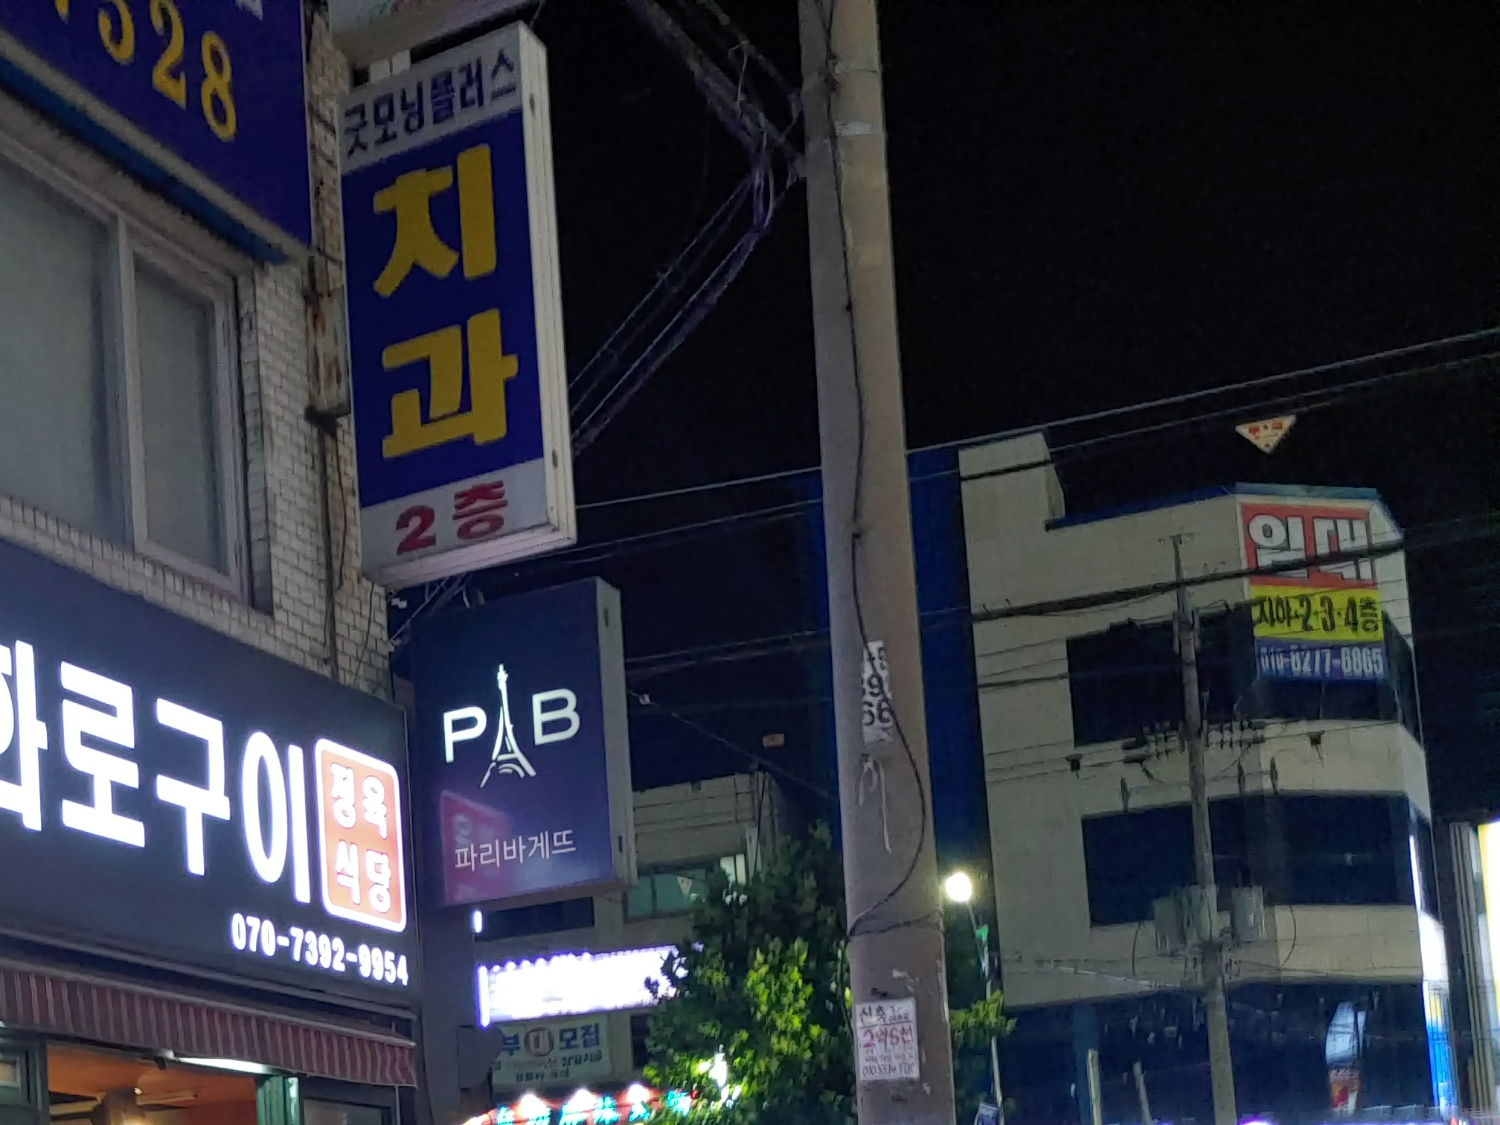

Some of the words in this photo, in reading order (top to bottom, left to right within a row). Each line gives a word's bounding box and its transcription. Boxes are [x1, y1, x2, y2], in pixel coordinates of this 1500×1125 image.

[372, 143, 519, 459] 치과
[395, 479, 509, 554] 2층
[331, 761, 388, 840] 정육
[336, 838, 392, 913] 식당
[454, 829, 576, 872] 파리바게뜨
[231, 912, 409, 986] 070-7392-9954
